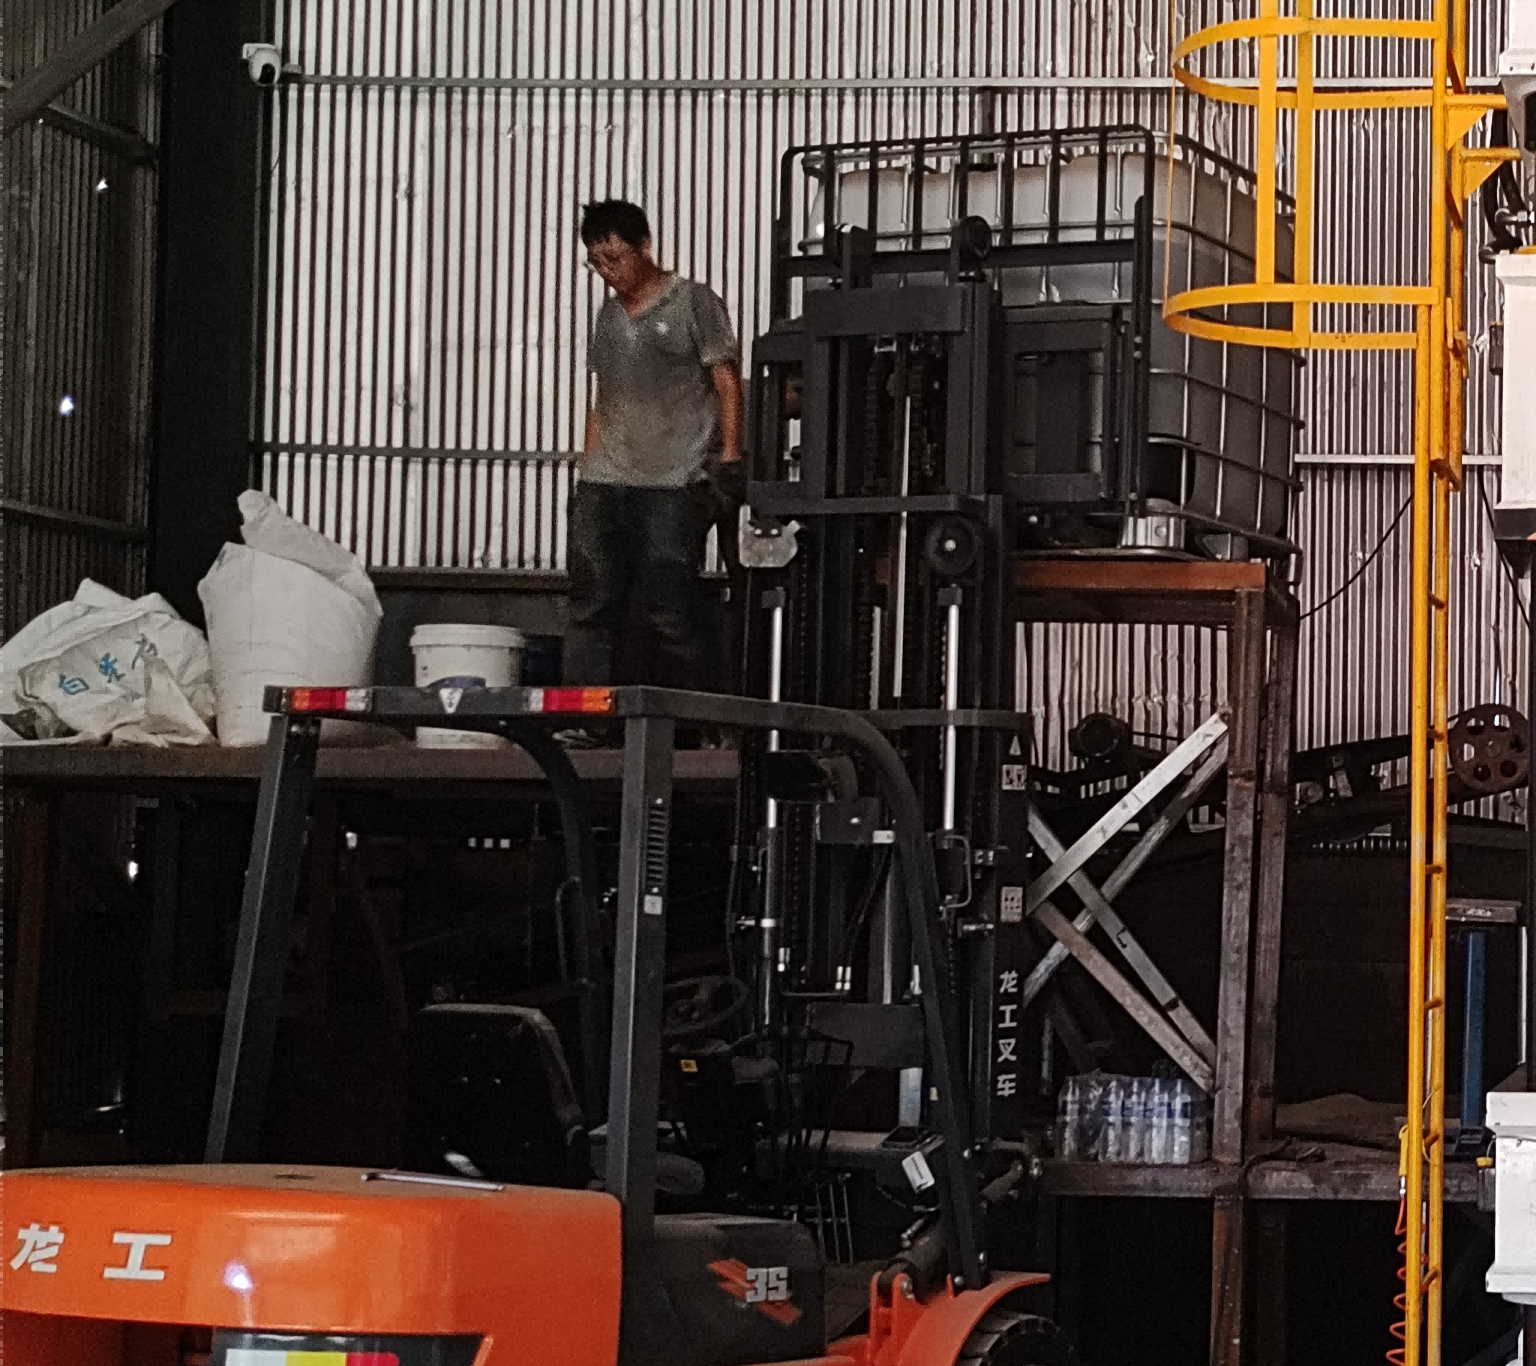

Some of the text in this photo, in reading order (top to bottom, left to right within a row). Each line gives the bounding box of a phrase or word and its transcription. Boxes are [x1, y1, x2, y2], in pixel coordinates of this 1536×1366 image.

[996, 969, 1019, 1098] 龙工叉车
[9, 1222, 173, 1282] 龙工
